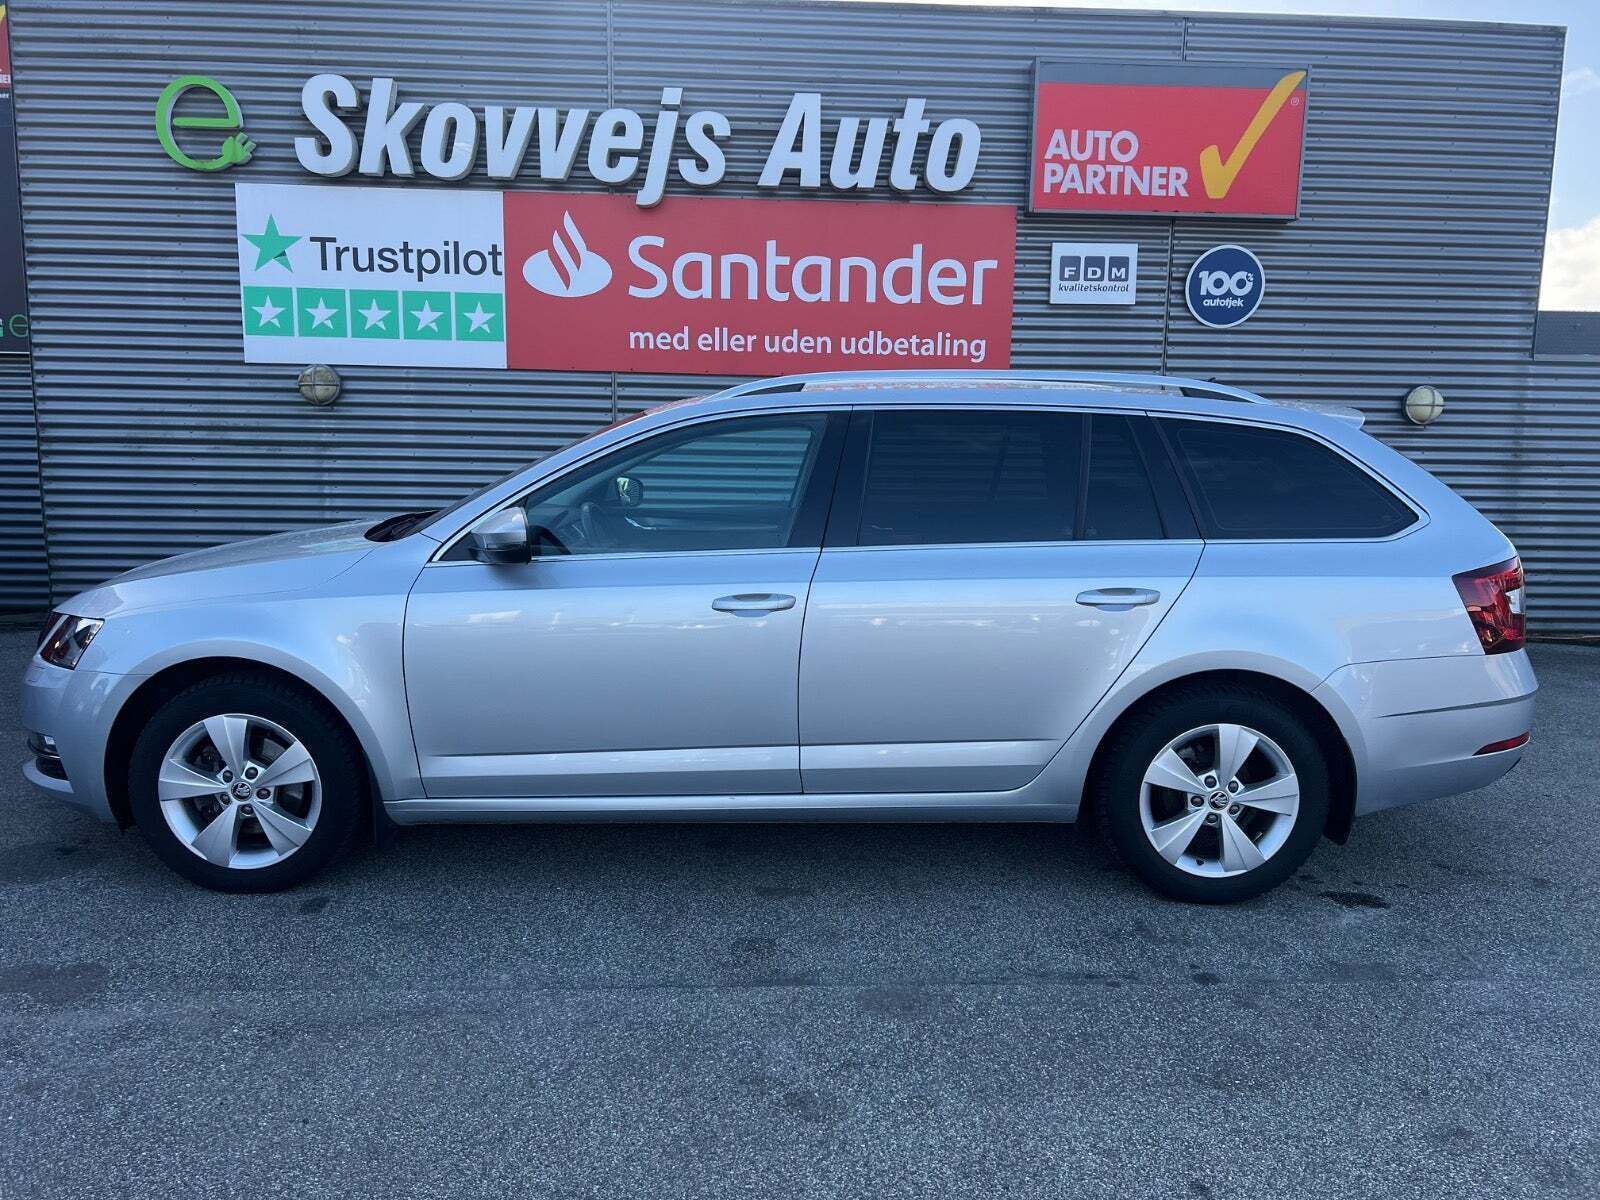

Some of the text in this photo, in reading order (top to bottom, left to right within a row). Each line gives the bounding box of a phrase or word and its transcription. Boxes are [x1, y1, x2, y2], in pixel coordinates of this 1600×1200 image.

[294, 73, 983, 207] Skovvejs Auto
[1044, 128, 1139, 163] AUTO
[1043, 162, 1190, 198] PARTNER
[309, 235, 503, 283] Trustpilot
[627, 234, 999, 306] Santander
[1063, 266, 1127, 280] FDM
[1058, 282, 1129, 293] kvalitetskontrol
[1202, 297, 1244, 309] autotjek
[629, 325, 987, 363] med eller uden udbetaling
